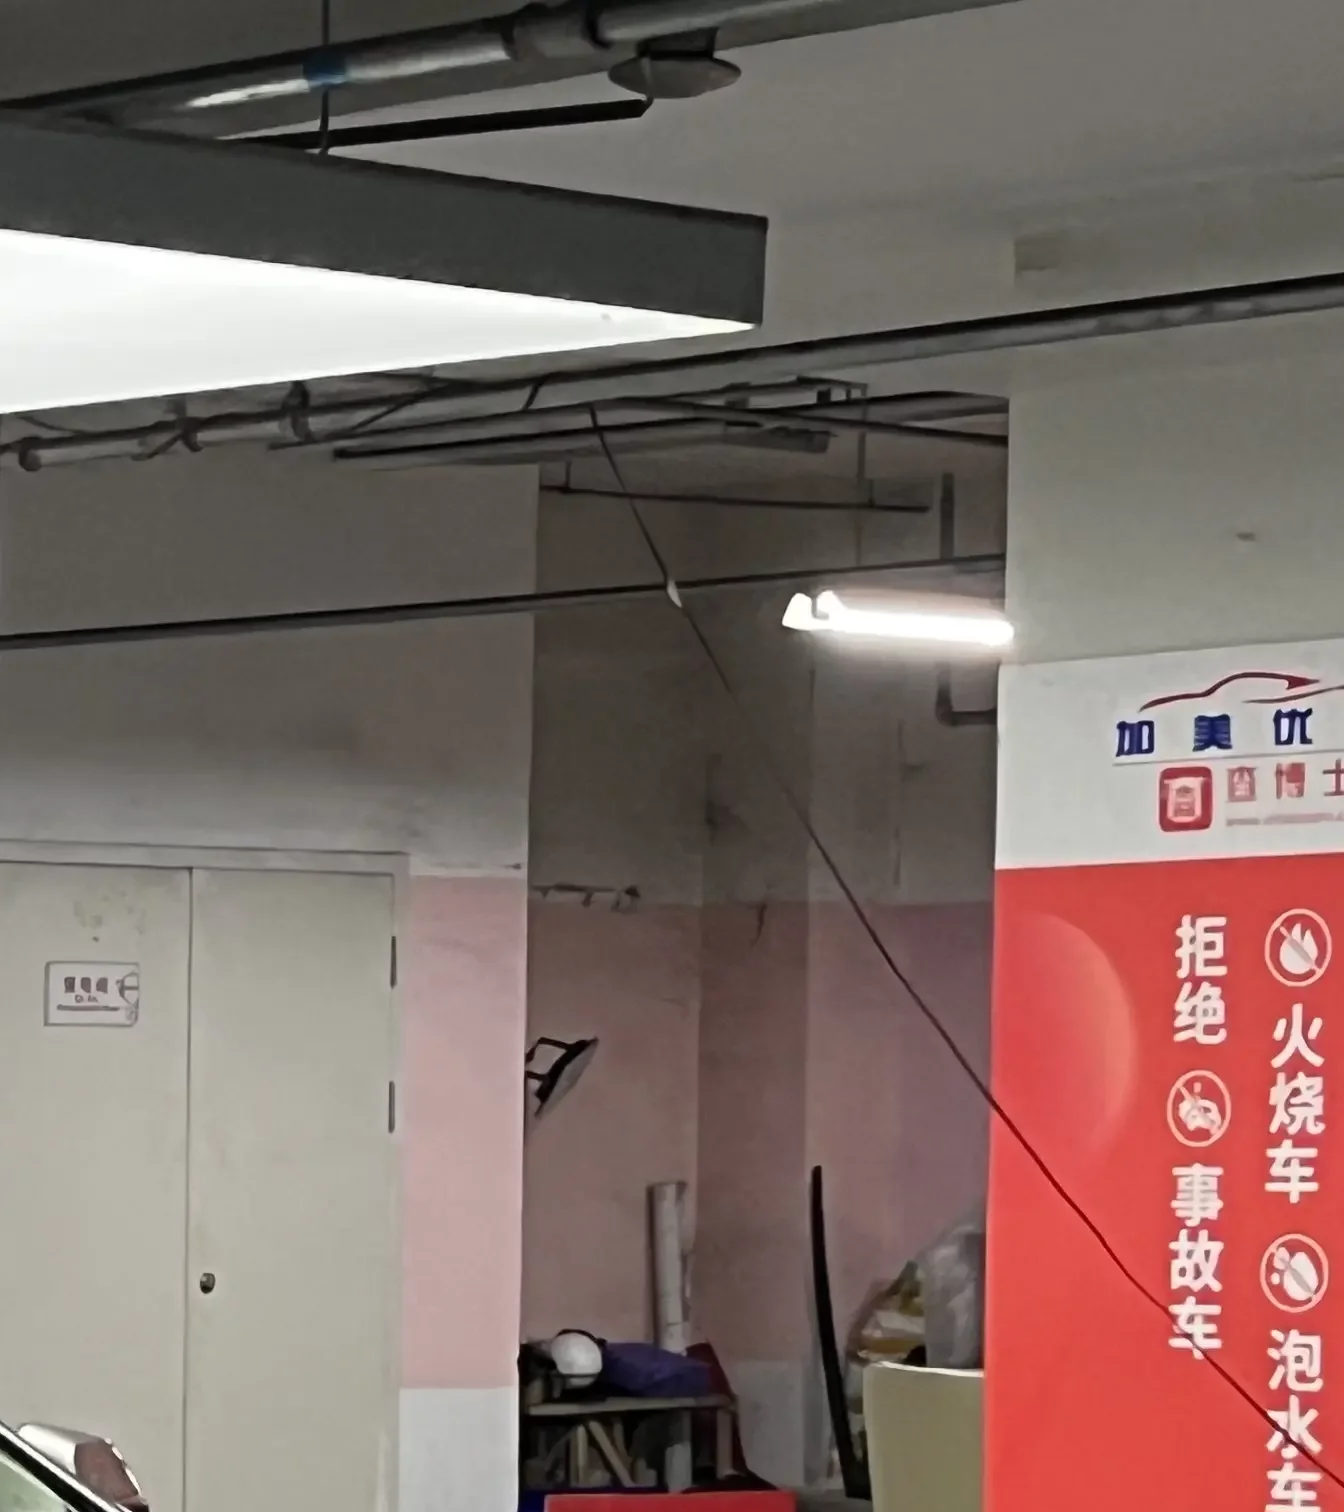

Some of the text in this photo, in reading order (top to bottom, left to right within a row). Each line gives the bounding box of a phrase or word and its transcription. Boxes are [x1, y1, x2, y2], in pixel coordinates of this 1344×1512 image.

[1168, 913, 1229, 1359] 拒绝 事故车
[1264, 1003, 1326, 1204] 火烧车
